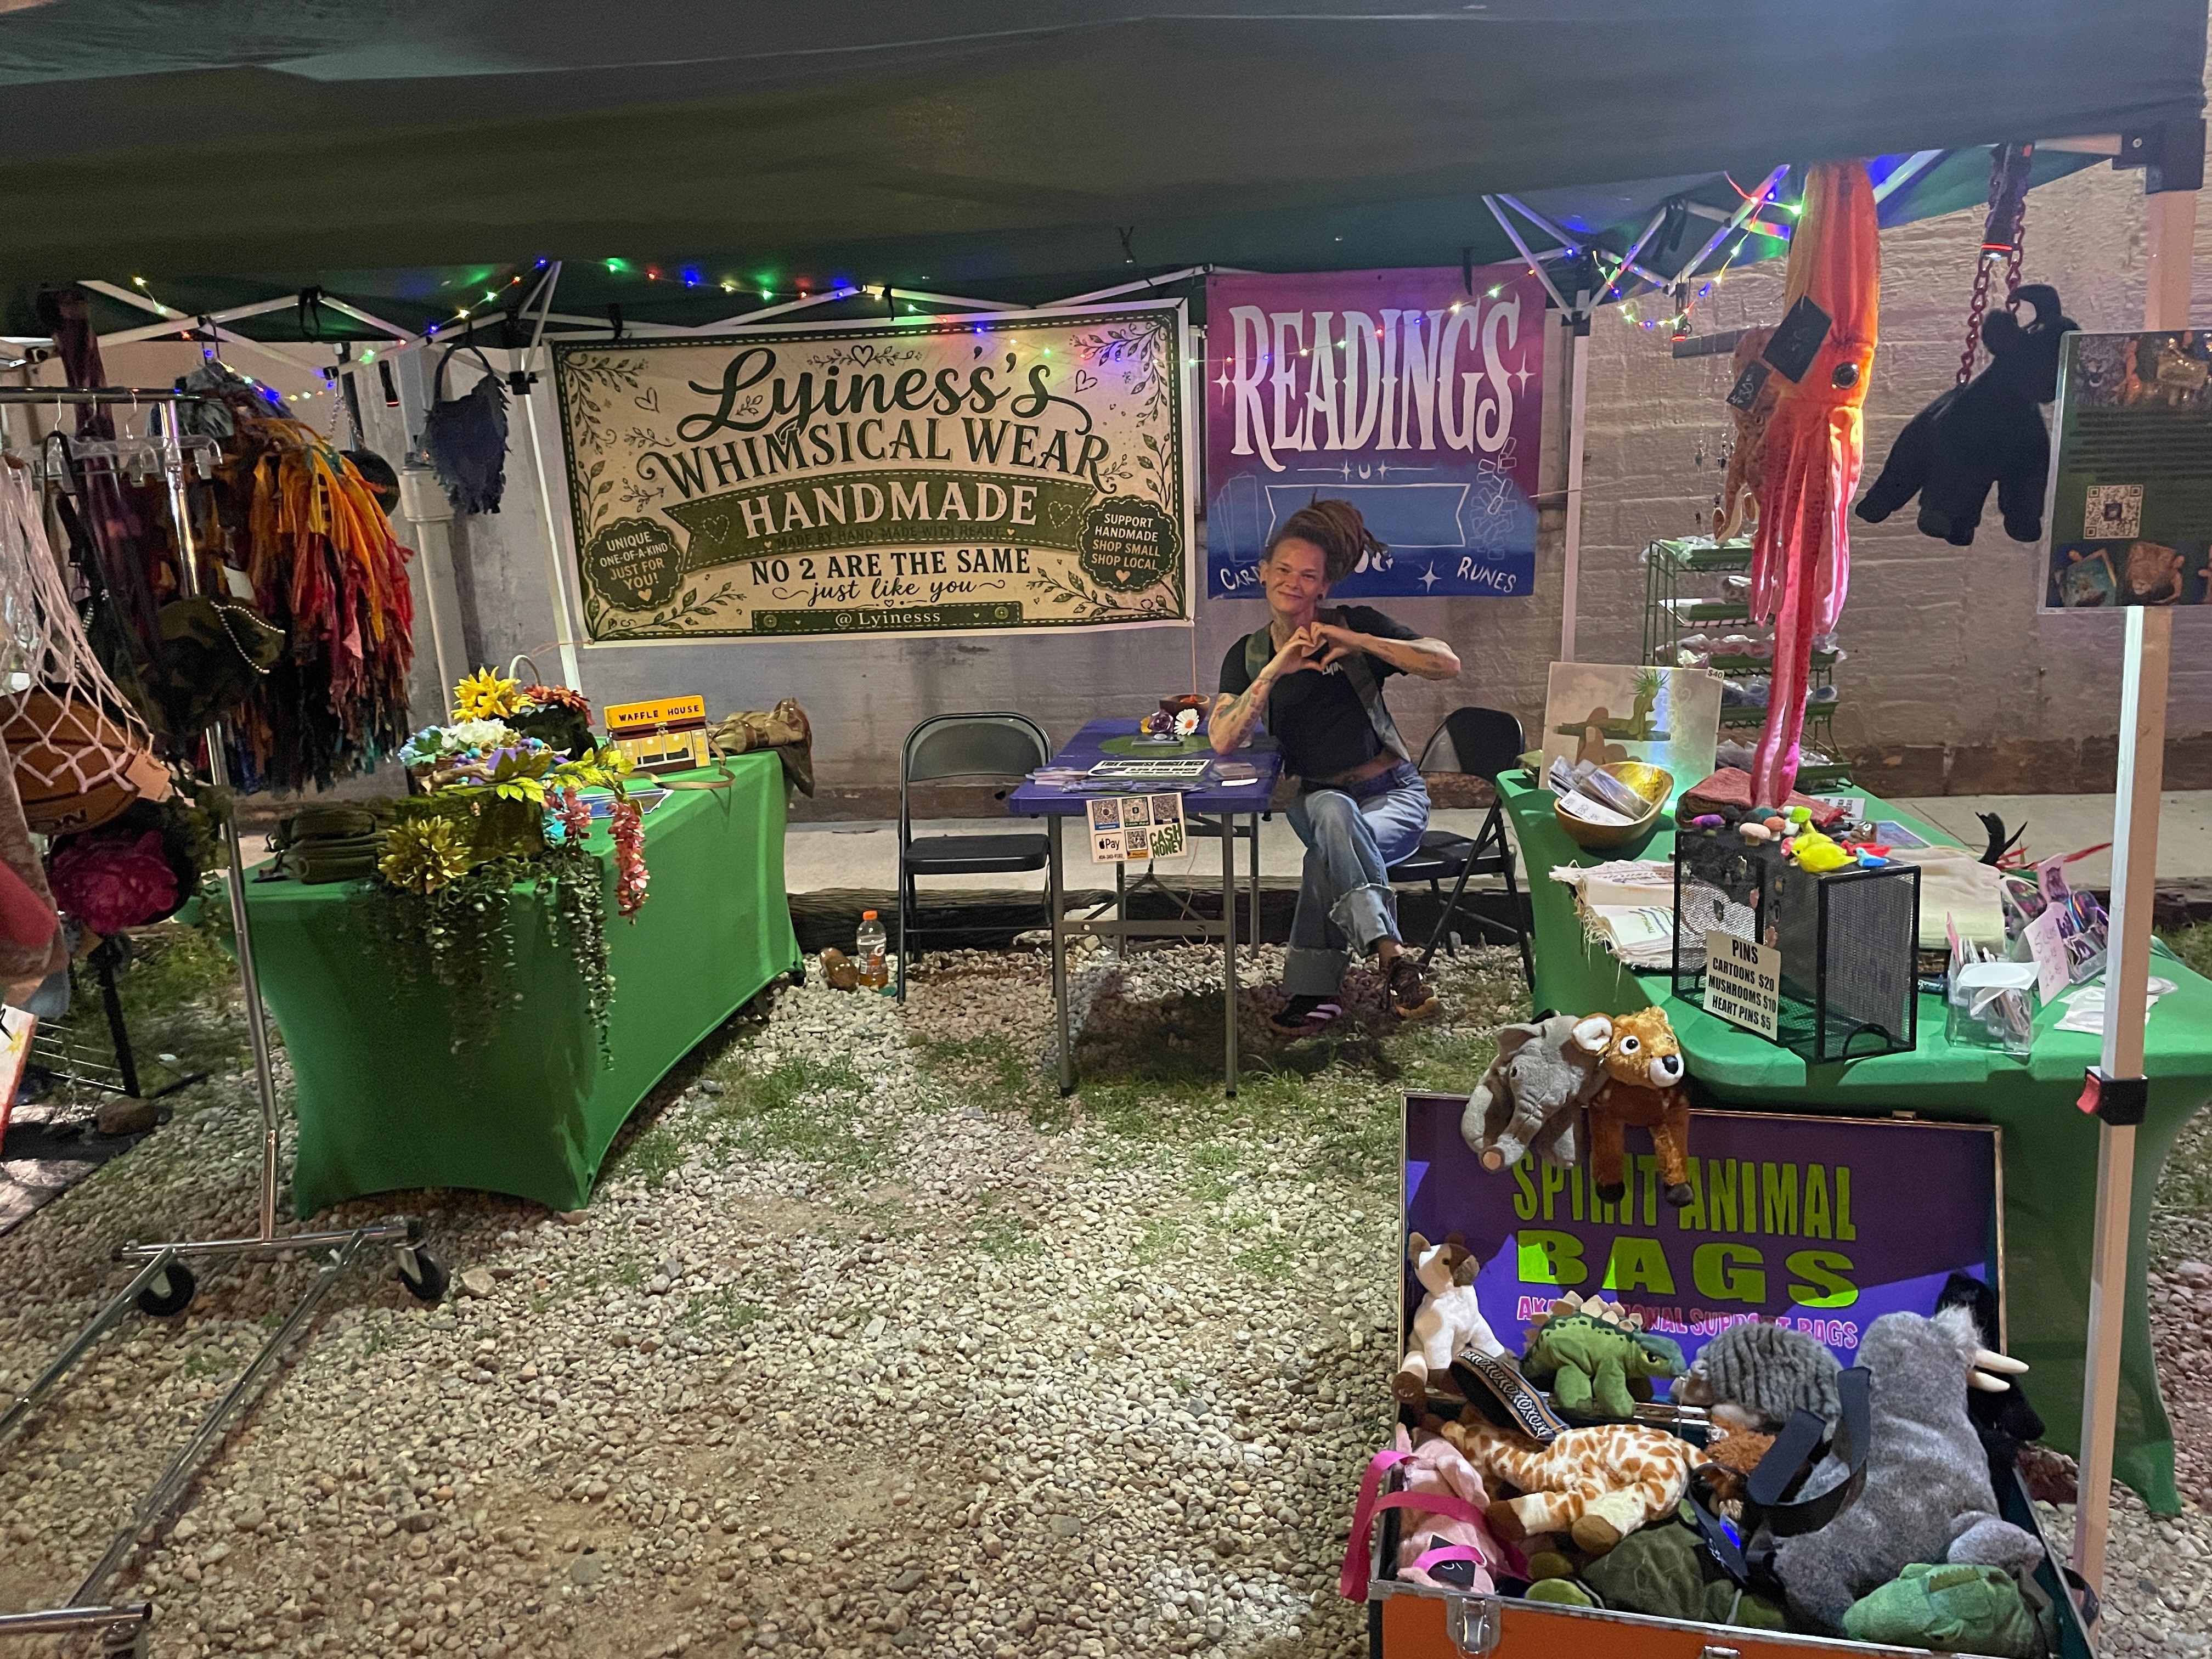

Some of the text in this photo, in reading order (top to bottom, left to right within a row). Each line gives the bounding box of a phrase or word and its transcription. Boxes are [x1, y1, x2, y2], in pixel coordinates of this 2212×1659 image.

[1228, 291, 1520, 472] READINGS
[637, 417, 1118, 499] WHIMSICAL WEAR
[737, 481, 1039, 539] HANDMADE
[1104, 514, 1154, 528] SUPPORT
[606, 531, 652, 551] UNIQUE
[776, 533, 812, 549] MADE
[817, 531, 832, 544] BY
[879, 526, 917, 539] MADE
[921, 523, 955, 537] WITH
[1095, 526, 1158, 542] HANDMADE
[600, 543, 668, 567] ONE-OF-A-KIND
[1093, 539, 1161, 557] SHOP SMALL
[610, 557, 665, 580] JUST FOR
[750, 548, 1031, 585] NO 2 ARE THE SAME
[1091, 553, 1158, 570] SHOP LOCAL
[623, 572, 659, 590] YOU!
[1457, 556, 1516, 593] RUNES
[808, 577, 978, 607] just like you
[835, 610, 941, 629] @ Lyinesss
[1707, 669, 1723, 679] $40
[618, 704, 700, 722] WAFFLE HOUSE
[1105, 838, 1120, 850] Pay
[1149, 823, 1183, 847] CASH
[1152, 838, 1183, 858] MONEY
[1731, 939, 1759, 964] PINS
[1712, 957, 1775, 992] CARTOONS $20
[1708, 974, 1776, 1013] MUSHROOMS $10
[1712, 995, 1771, 1031] HEART PINS $5
[1517, 1229, 1859, 1308] BAGS
[1797, 1318, 1858, 1349] BAGS
